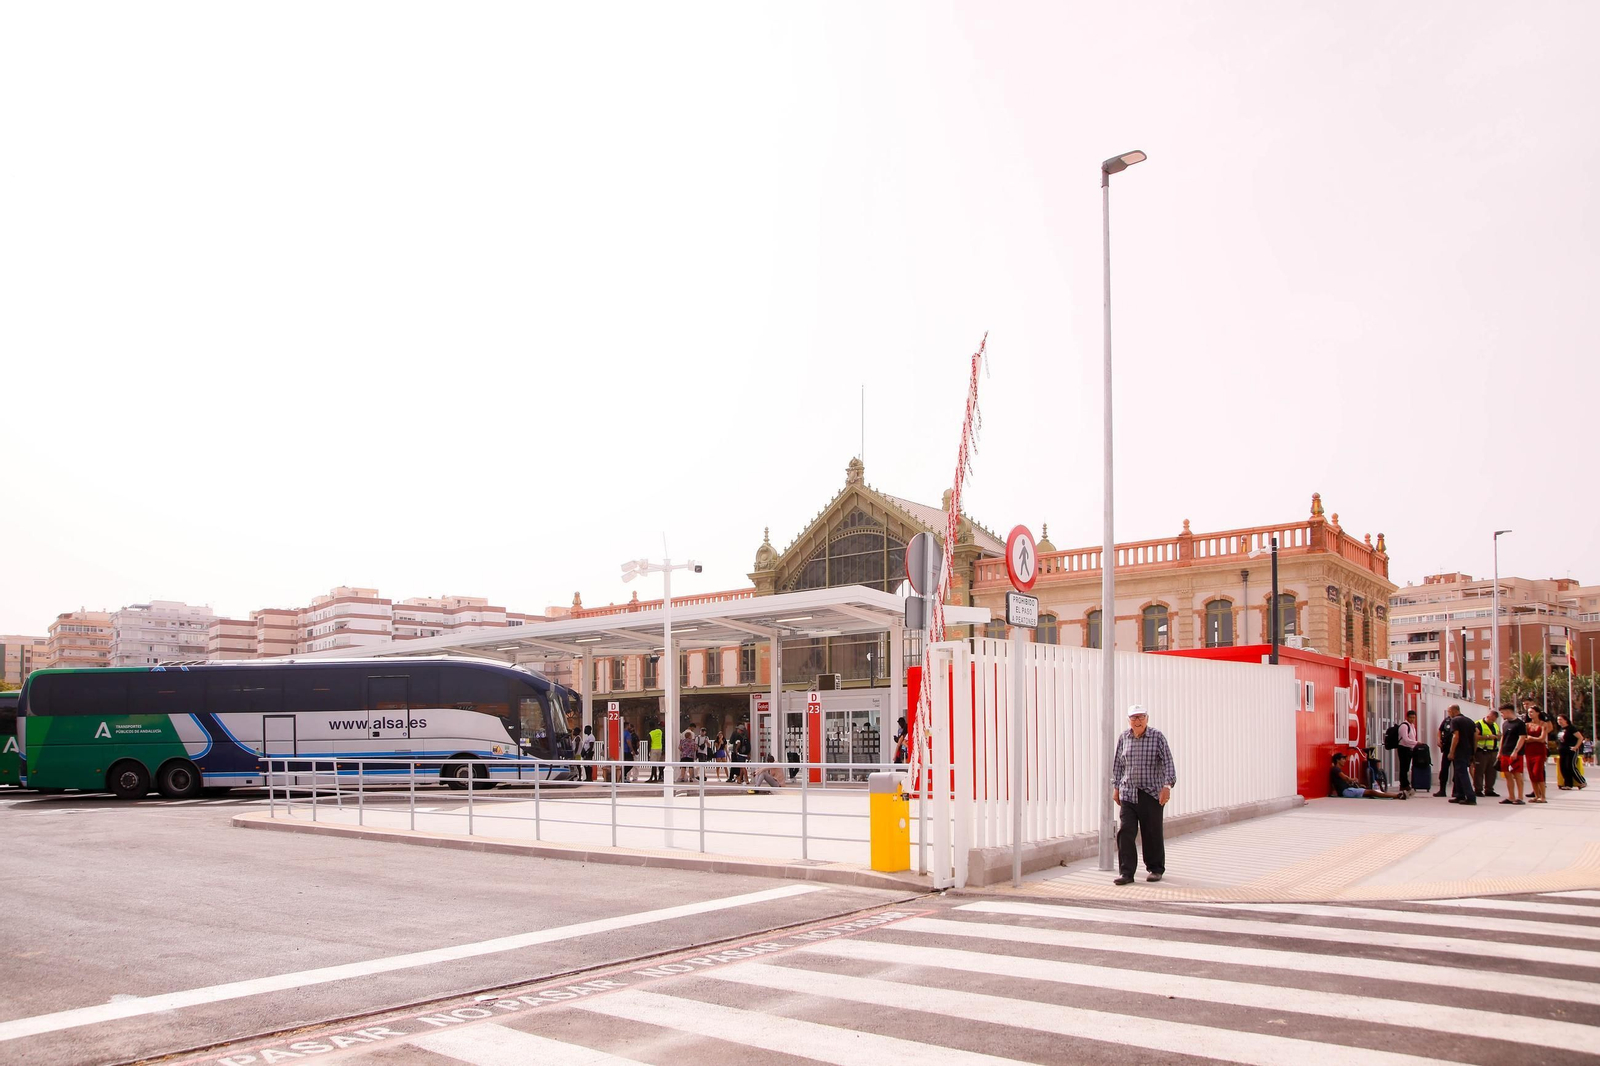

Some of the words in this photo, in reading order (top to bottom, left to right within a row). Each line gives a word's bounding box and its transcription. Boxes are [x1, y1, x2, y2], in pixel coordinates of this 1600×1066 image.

[1012, 595, 1035, 607] PROHIBIDO
[1015, 606, 1021, 614] EL
[1021, 607, 1032, 615] PASO
[1016, 615, 1036, 625] PEATONES
[811, 693, 818, 702] D
[611, 703, 617, 711] D
[808, 705, 820, 714] 23
[609, 712, 619, 721] 22
[328, 716, 427, 730] www.alsa.es
[791, 929, 841, 942] NO
[841, 911, 912, 932] PASAR
[633, 962, 694, 978] NO
[690, 941, 794, 966] PASAR
[416, 1007, 493, 1027] NO
[494, 979, 629, 1011] PASAR
[218, 1026, 407, 1066] PASAR
